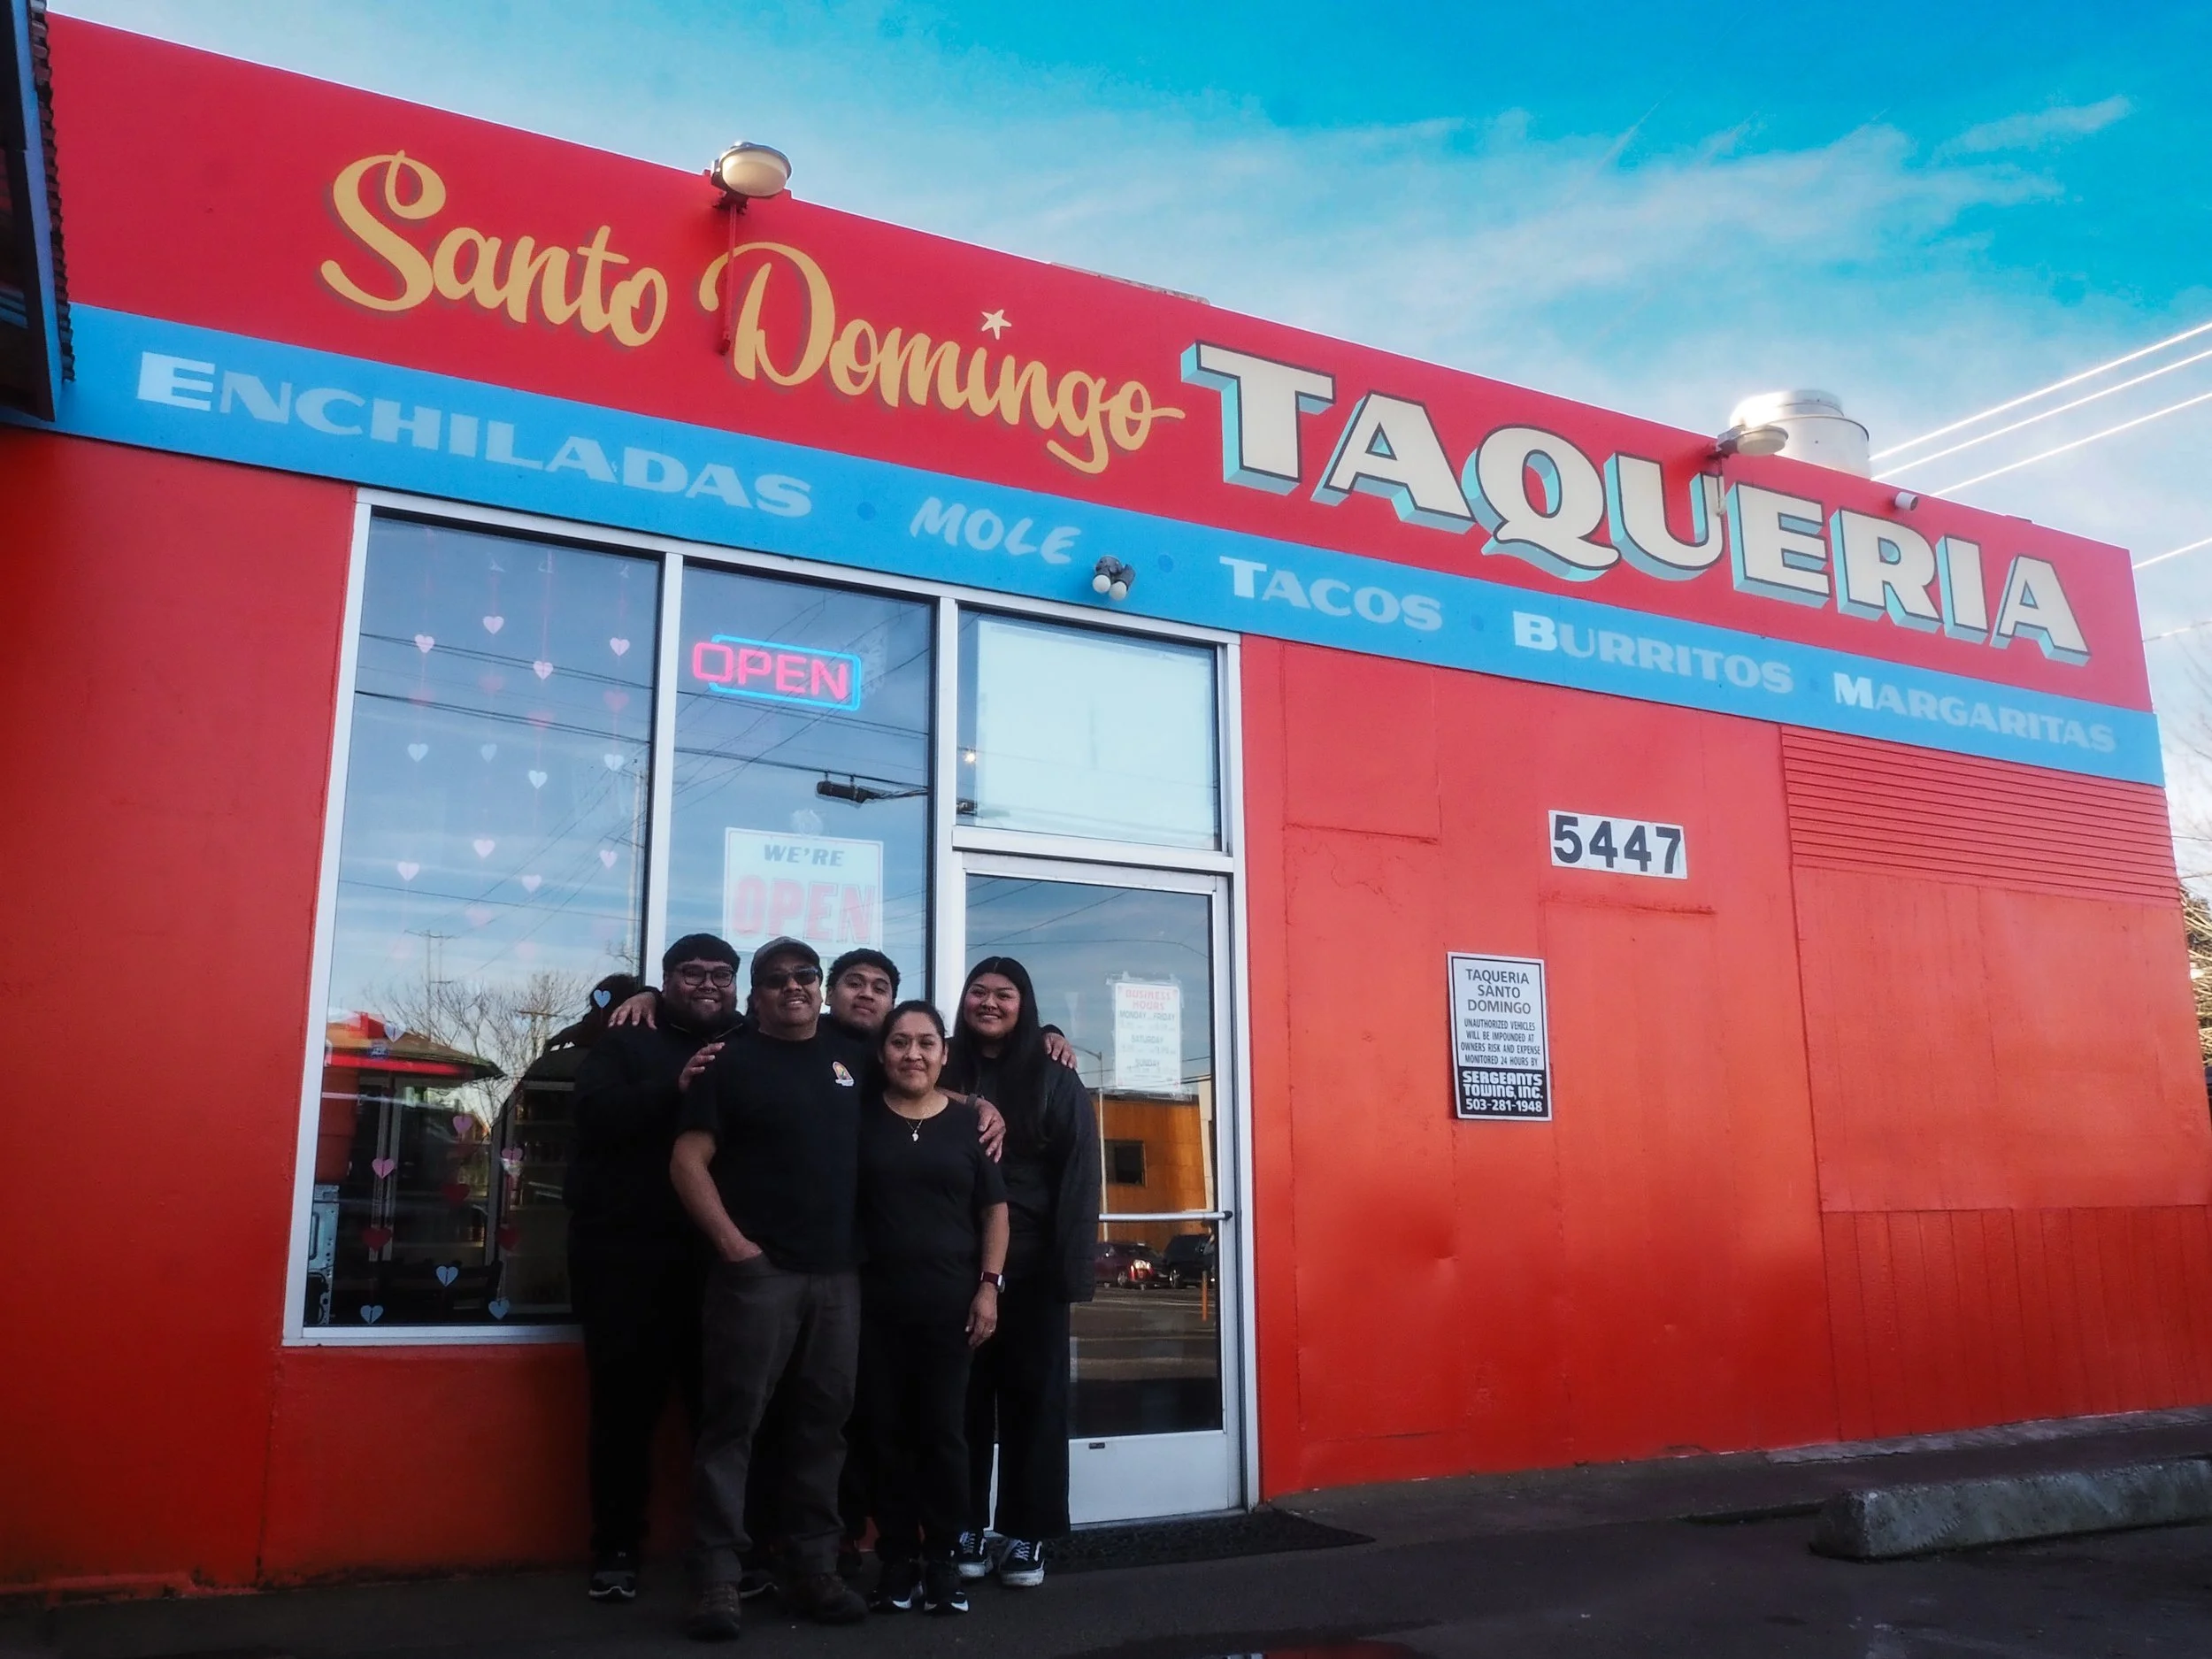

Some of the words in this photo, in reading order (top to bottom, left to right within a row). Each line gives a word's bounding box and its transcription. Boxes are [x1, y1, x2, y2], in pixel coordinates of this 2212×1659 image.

[320, 150, 669, 347] Santo
[699, 242, 1186, 473] Domingo
[1181, 340, 2092, 667] TAQUERIA
[137, 351, 812, 518] ENCHILADAS
[909, 496, 1081, 565] MOLE
[1219, 555, 1442, 632] TACOS
[1512, 610, 1793, 695] BURRITOS
[1833, 672, 2117, 753] MARGARITAS
[693, 641, 849, 701] OPEN
[1553, 814, 1681, 874] 5447
[764, 843, 844, 867] WE'RE
[732, 874, 876, 945] OPEN
[1465, 968, 1530, 985] TAQUERIA
[1125, 989, 1171, 1001] BUSINESS
[1478, 985, 1521, 999] SANTO
[1133, 1000, 1165, 1010] HOURS
[1467, 999, 1532, 1015] DOMINGO
[1120, 1010, 1147, 1019] MONDAY
[1153, 1012, 1175, 1021] FRIDAY
[1463, 1018, 1509, 1030] UNAUTHORIZED
[1510, 1020, 1536, 1031] VEHICLES
[1131, 1034, 1164, 1043] SATURDAY
[1466, 1030, 1480, 1040] WILL
[1483, 1032, 1490, 1041] BE
[1492, 1032, 1525, 1042] IMPOUNDED
[1461, 1041, 1486, 1052] OWNERS
[1488, 1043, 1501, 1053] RISK
[1503, 1044, 1515, 1054] AND
[1517, 1045, 1540, 1055] EXPENSE
[1465, 1054, 1498, 1064] MONITORED
[1501, 1056, 1508, 1065] 24
[1509, 1056, 1529, 1066] HOURS
[1531, 1057, 1538, 1066] BY
[1462, 1071, 1543, 1087] SERGEANTS
[1463, 1083, 1517, 1100] TOWING,
[1517, 1086, 1543, 1099] INC.
[1465, 1098, 1543, 1112] 503-281-1948
